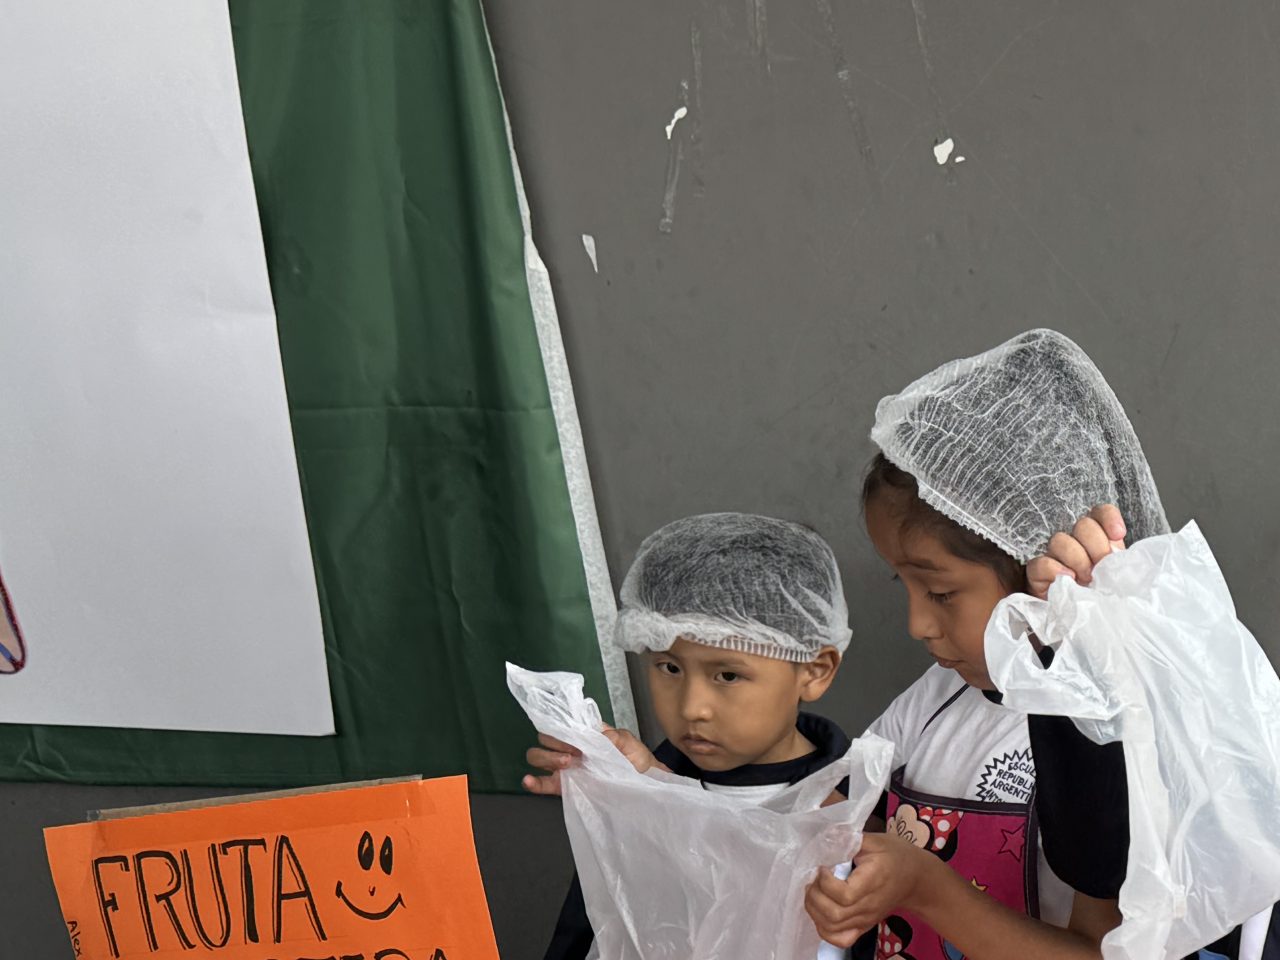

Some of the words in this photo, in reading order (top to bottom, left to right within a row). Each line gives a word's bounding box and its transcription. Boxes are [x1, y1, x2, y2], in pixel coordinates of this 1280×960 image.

[990, 779, 1031, 803] ARGENTI
[996, 768, 1034, 791] REPUBLI
[92, 835, 327, 958] FRUTA
